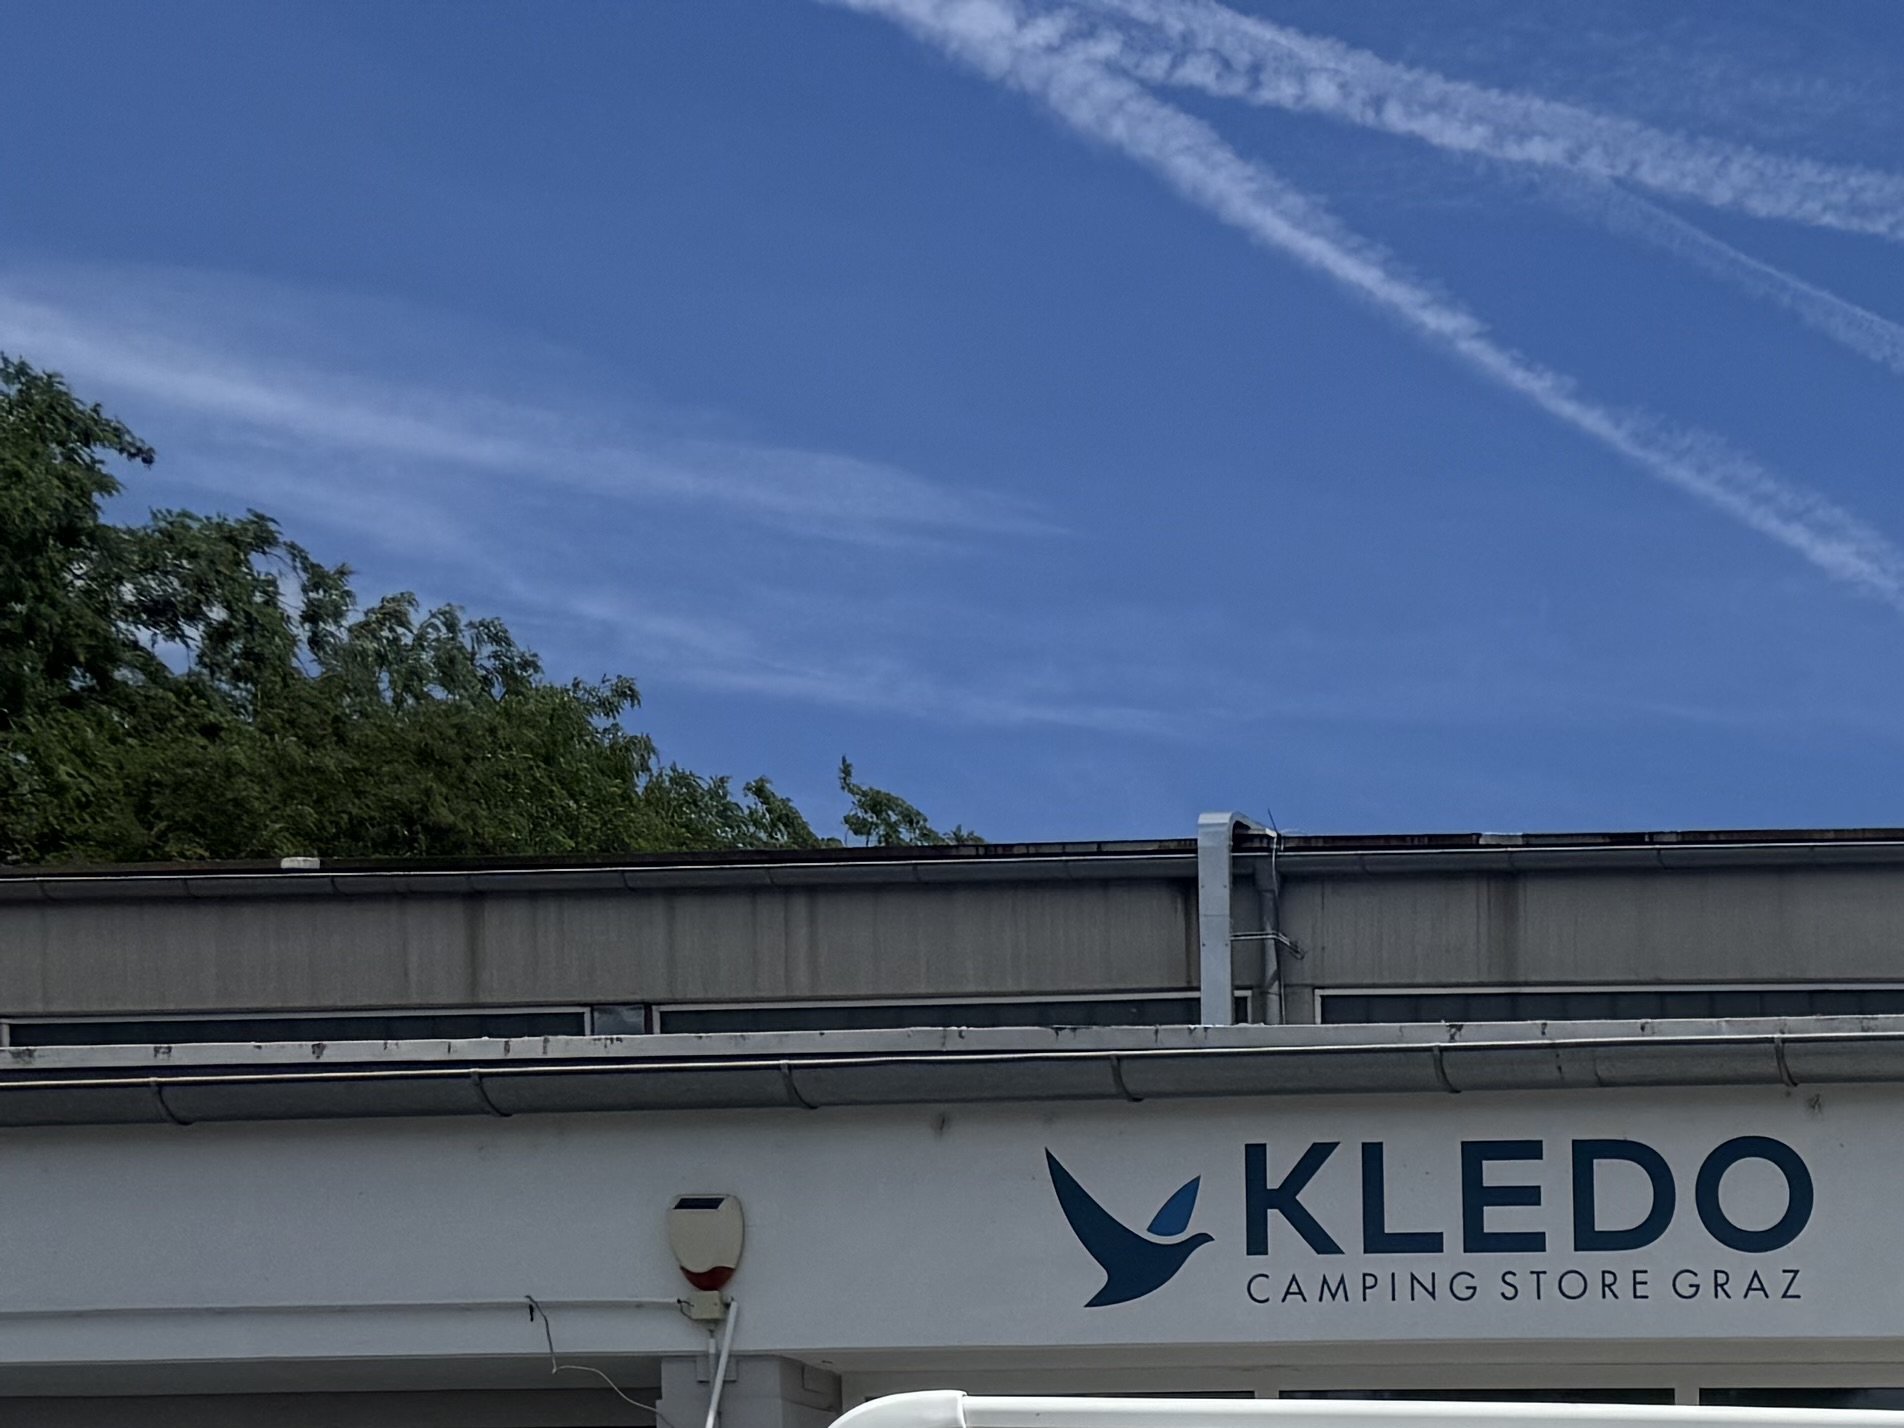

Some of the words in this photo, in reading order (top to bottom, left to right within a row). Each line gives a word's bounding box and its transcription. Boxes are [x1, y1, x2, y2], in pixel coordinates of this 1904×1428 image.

[1243, 1135, 1814, 1256] KLEDO
[1246, 1271, 1480, 1305] CAMPING
[1500, 1269, 1650, 1302] STORE
[1671, 1268, 1803, 1301] GRAZ
